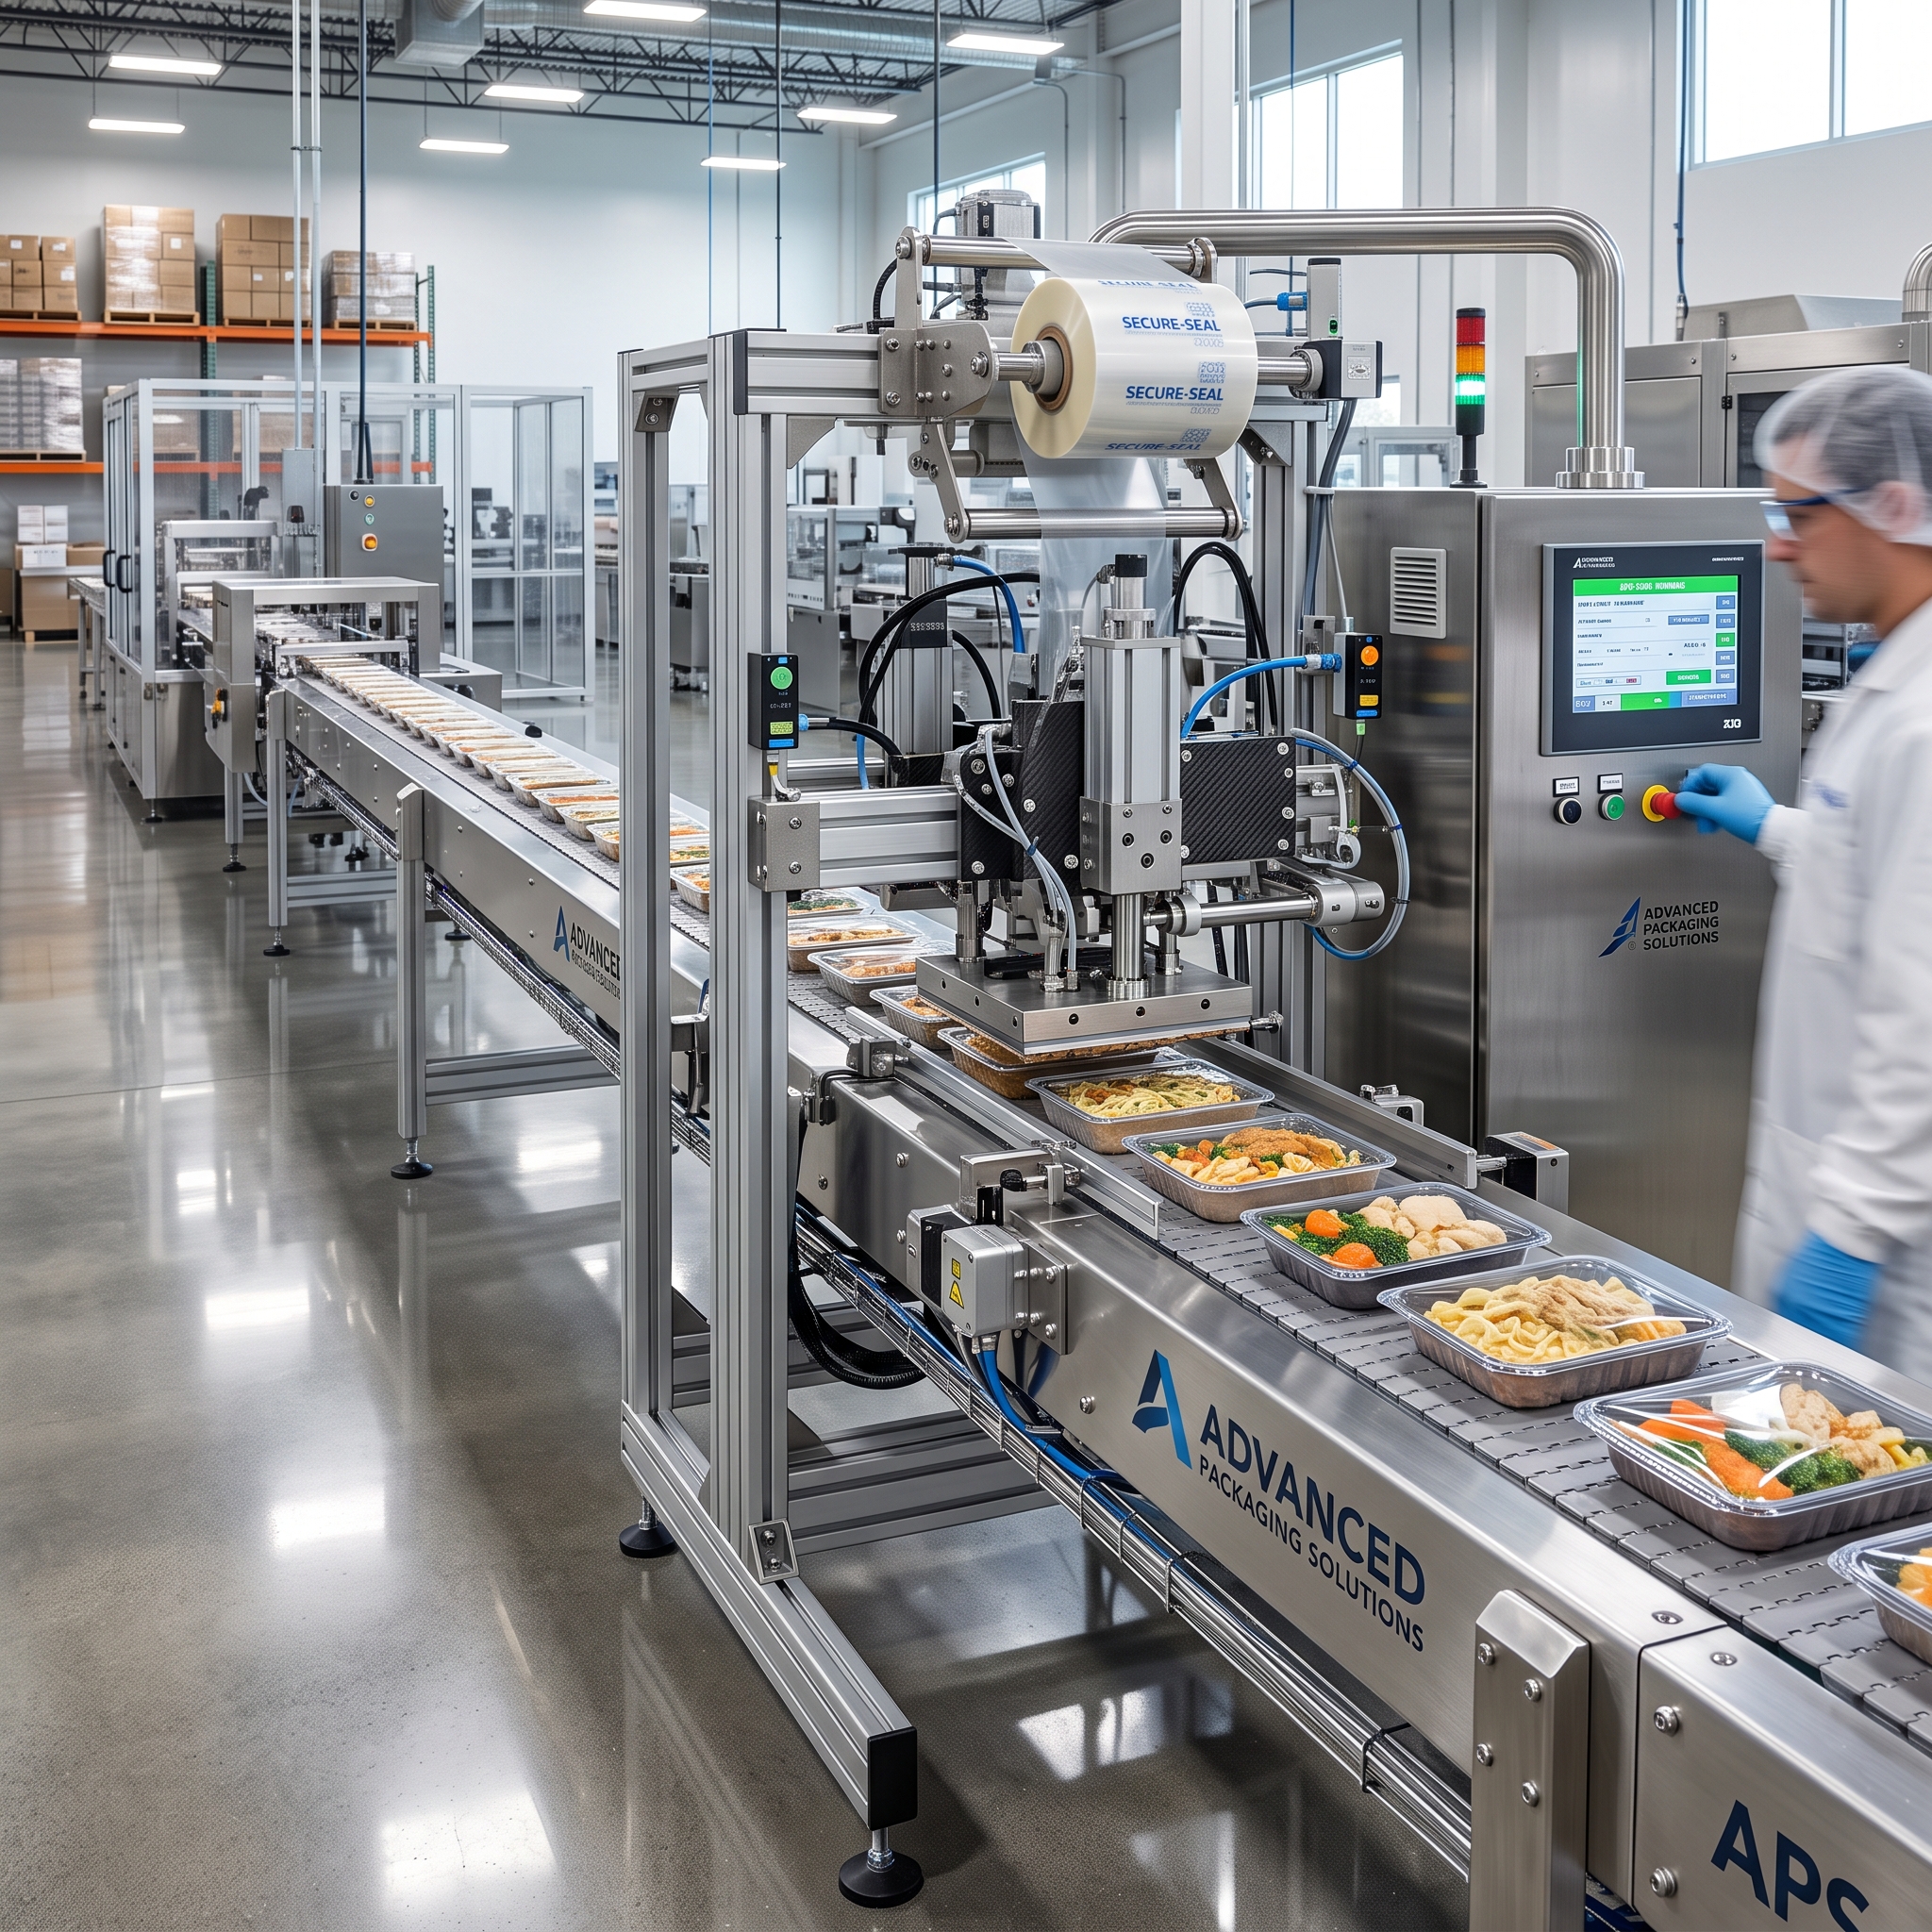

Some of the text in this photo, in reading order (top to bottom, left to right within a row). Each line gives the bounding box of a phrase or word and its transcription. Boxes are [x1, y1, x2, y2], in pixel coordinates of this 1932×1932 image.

[1122, 316, 1221, 331] SECURE-SEAL
[1125, 386, 1224, 401] SECURE-SEAL
[1643, 900, 1719, 920] ADVANCED
[1643, 916, 1719, 936] PACKAGING
[1643, 931, 1719, 951] SOLUTIONS
[1199, 1404, 1424, 1606] ADVANCED
[1200, 1454, 1424, 1652] PACKAGING SOLUTIONS
